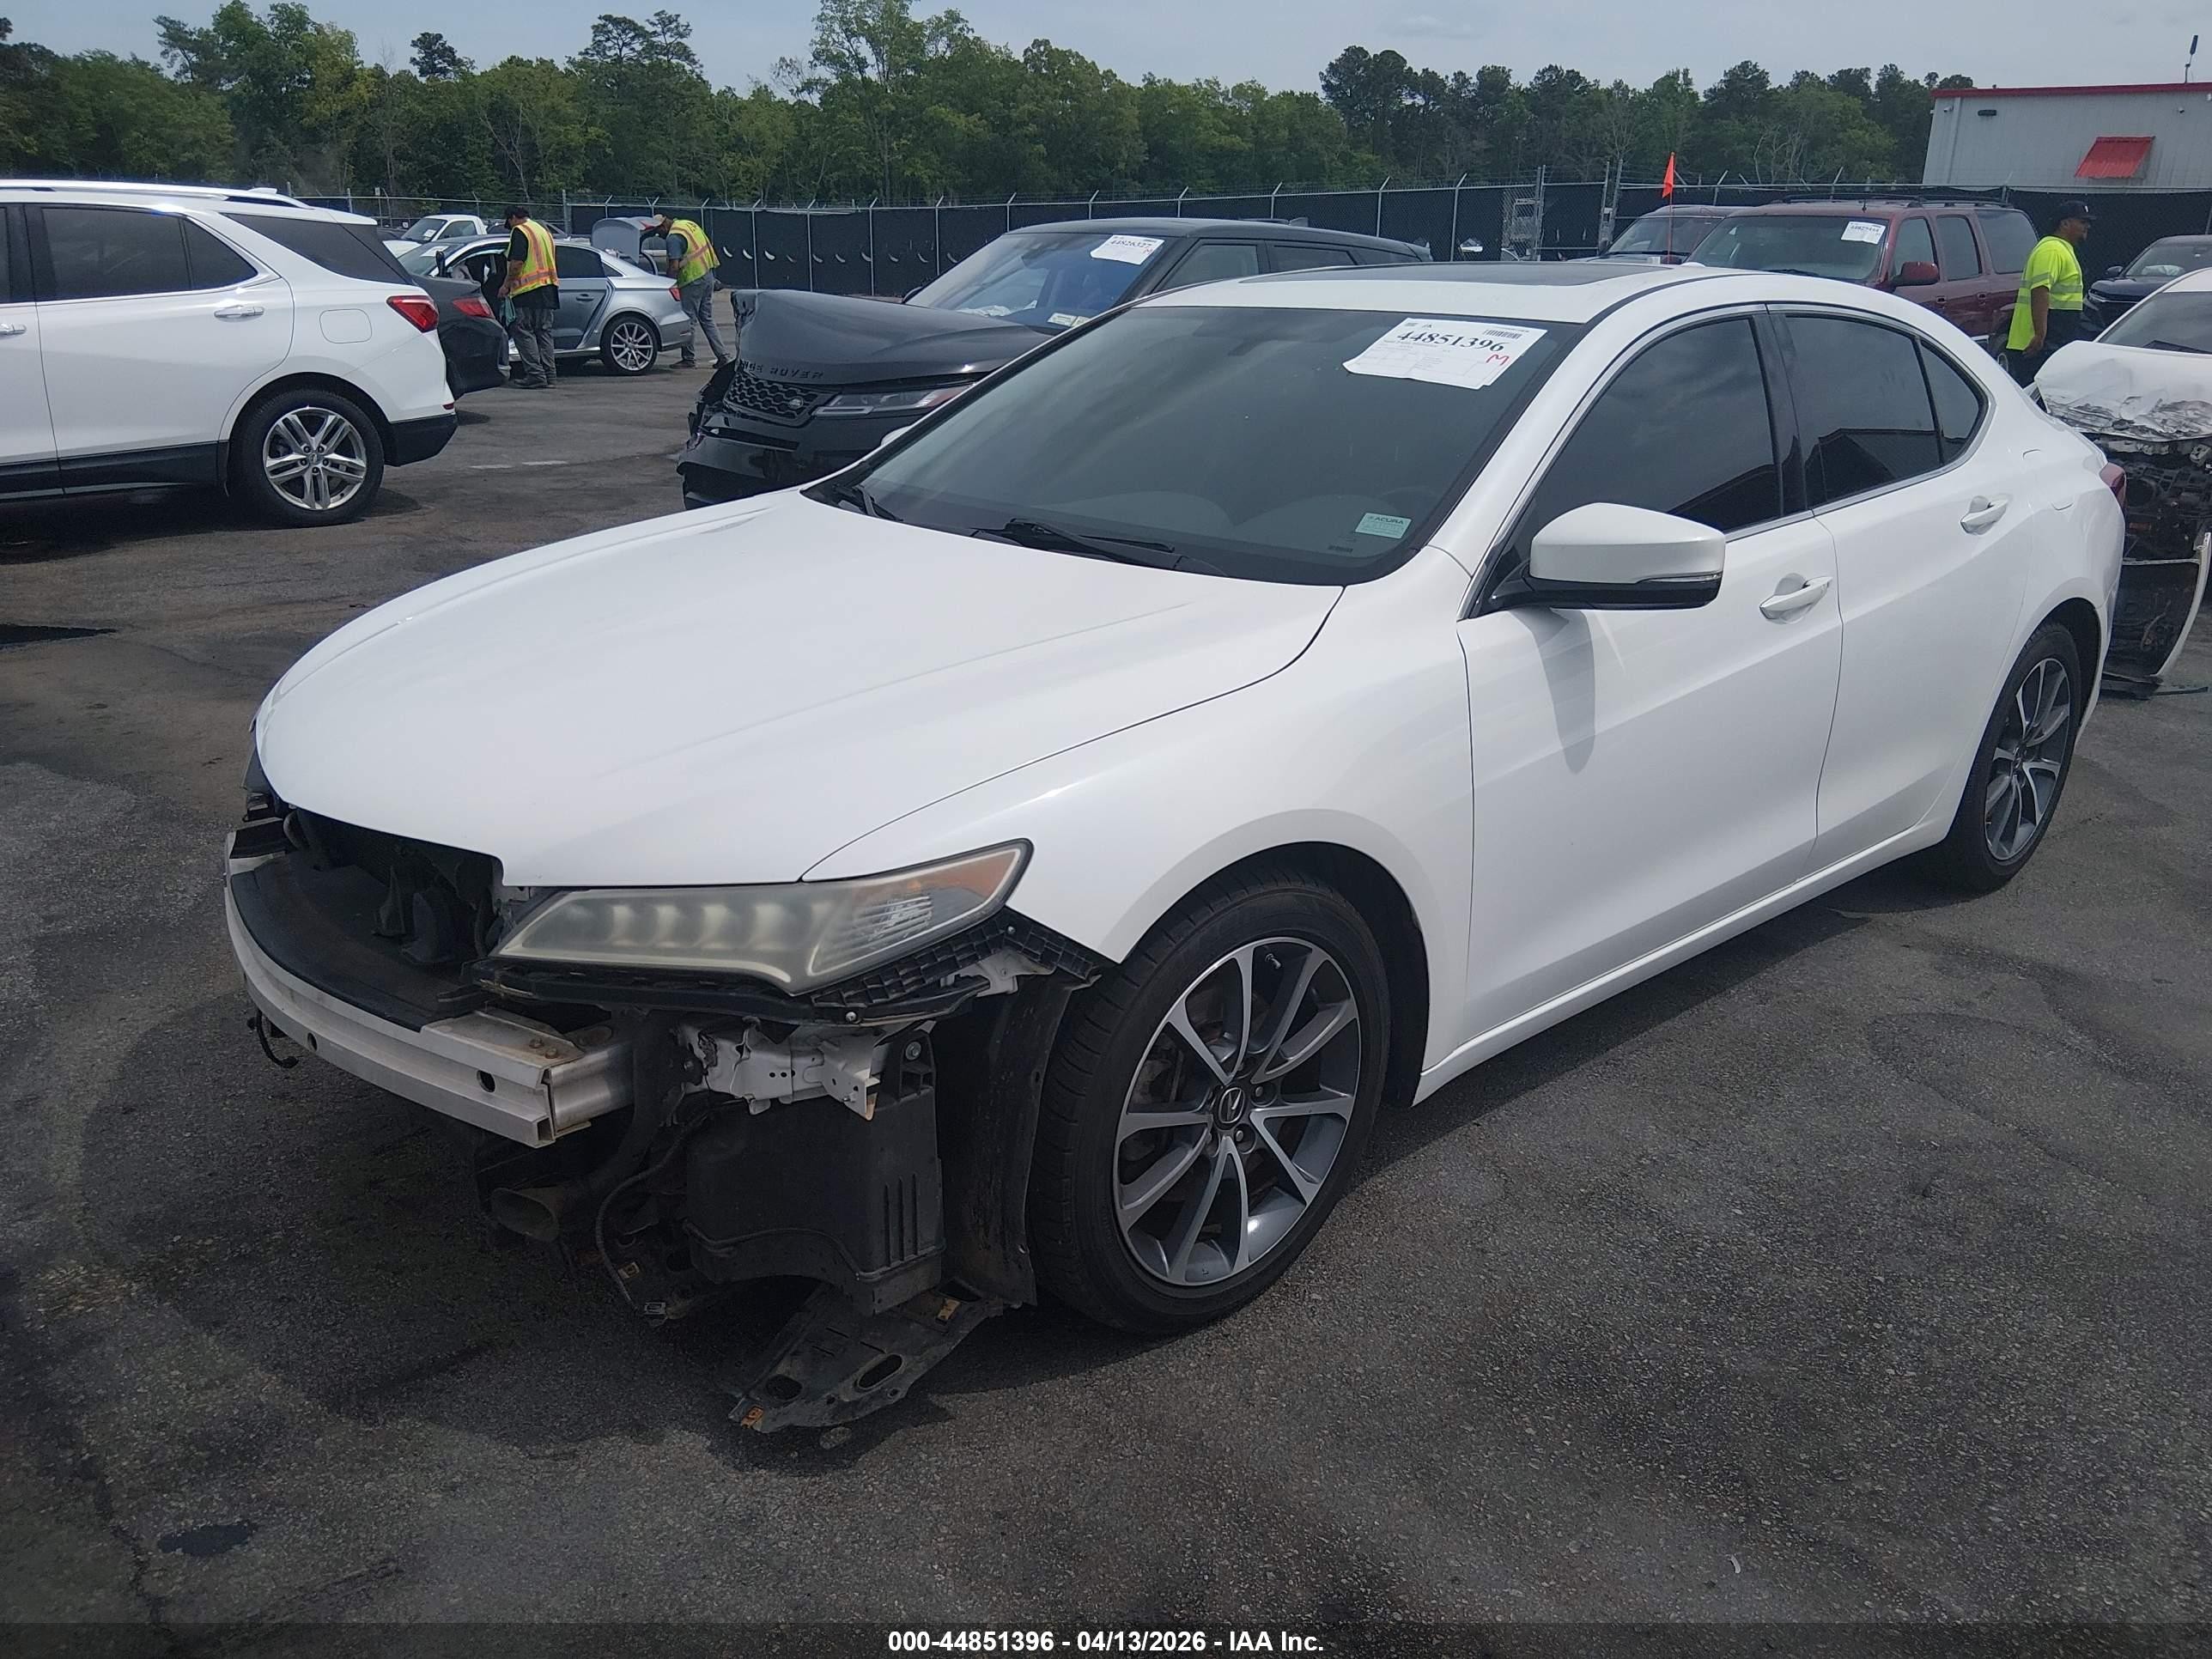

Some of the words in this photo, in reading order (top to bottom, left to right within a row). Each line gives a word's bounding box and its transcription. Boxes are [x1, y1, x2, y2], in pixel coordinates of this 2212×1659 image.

[1397, 331, 1510, 352] 44851396
[1486, 353, 1510, 367] M
[769, 367, 824, 380] ROVER
[1374, 516, 1404, 525] ACURA
